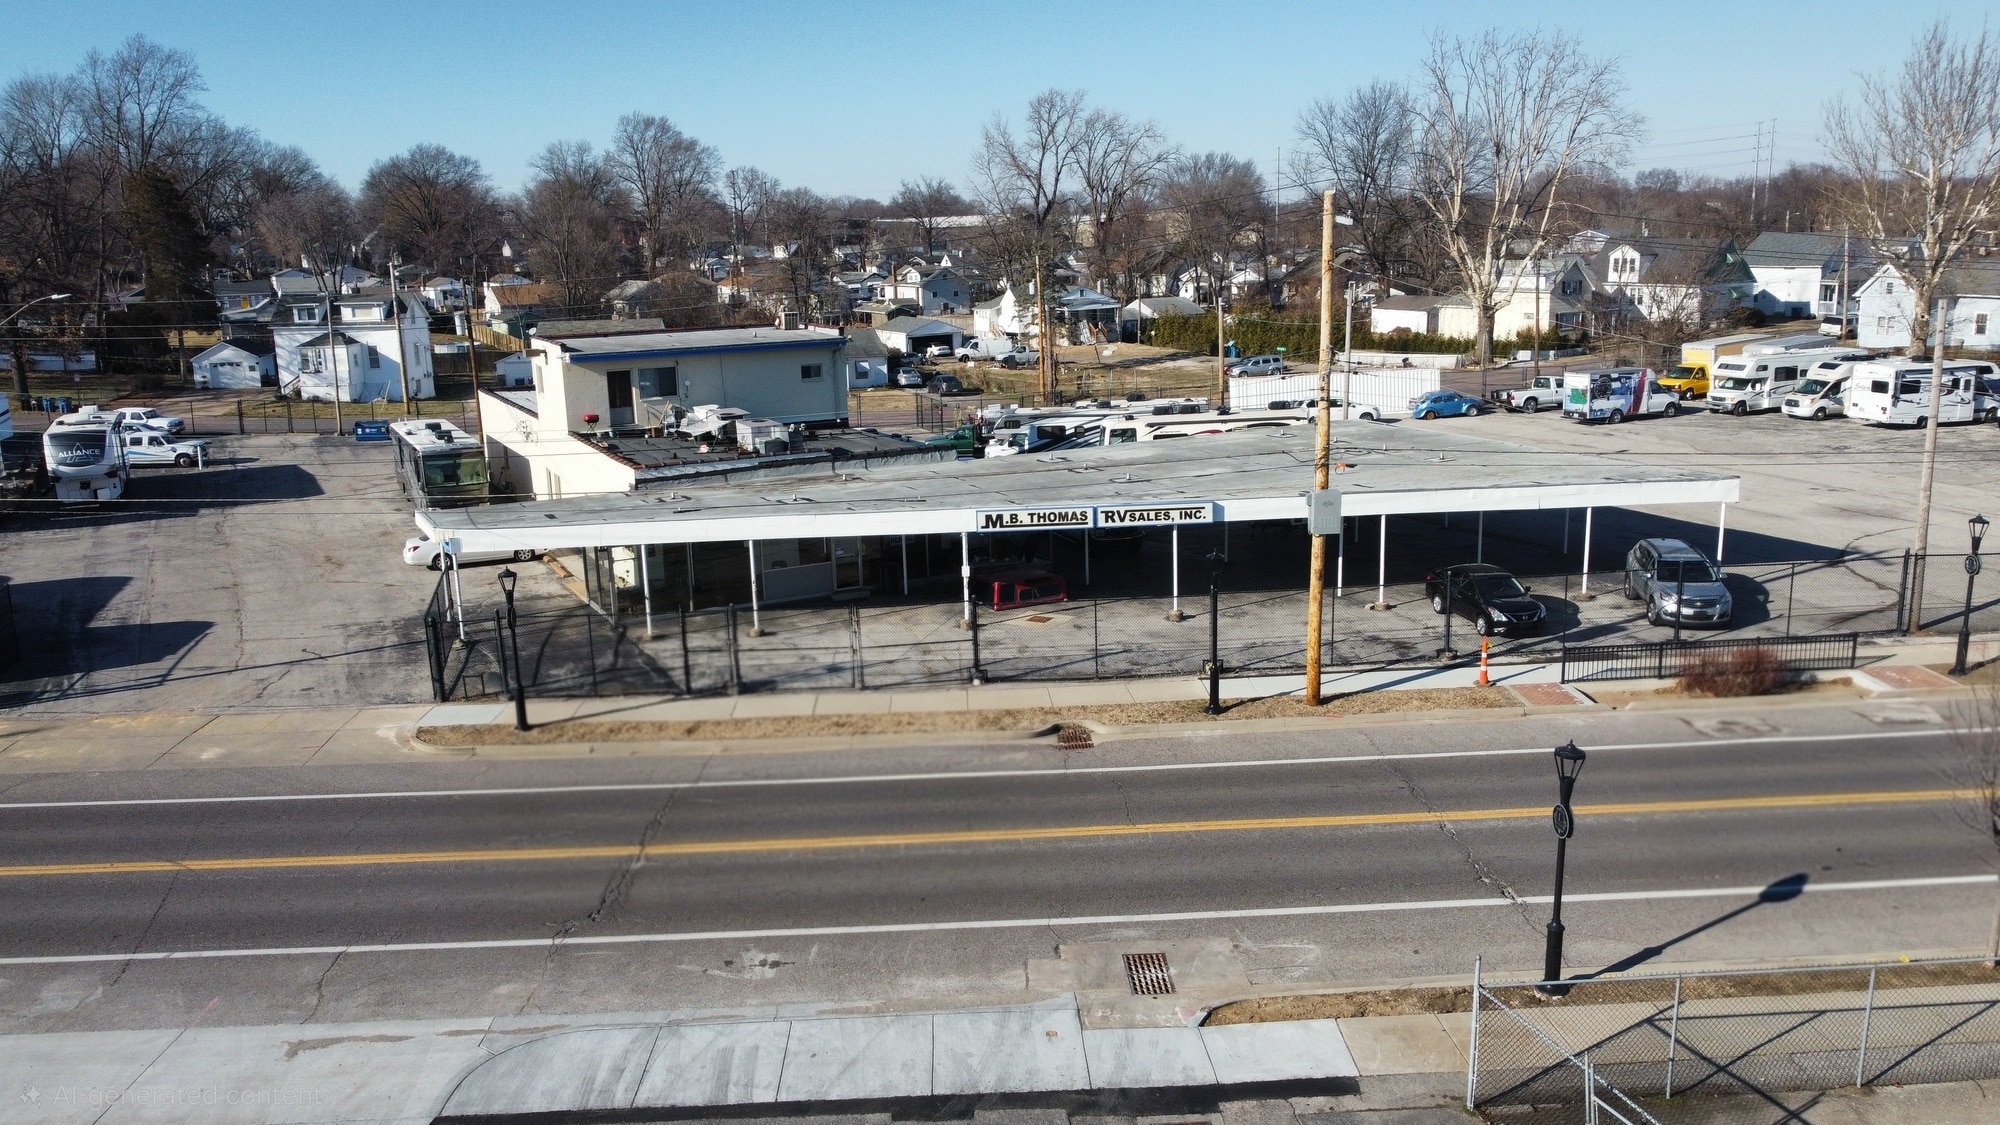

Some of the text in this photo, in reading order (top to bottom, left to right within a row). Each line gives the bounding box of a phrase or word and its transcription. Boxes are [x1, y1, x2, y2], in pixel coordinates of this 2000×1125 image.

[58, 449, 101, 458] ALLIANCE
[981, 510, 1089, 529] M.B. THOMAS
[1179, 509, 1207, 521] INC.
